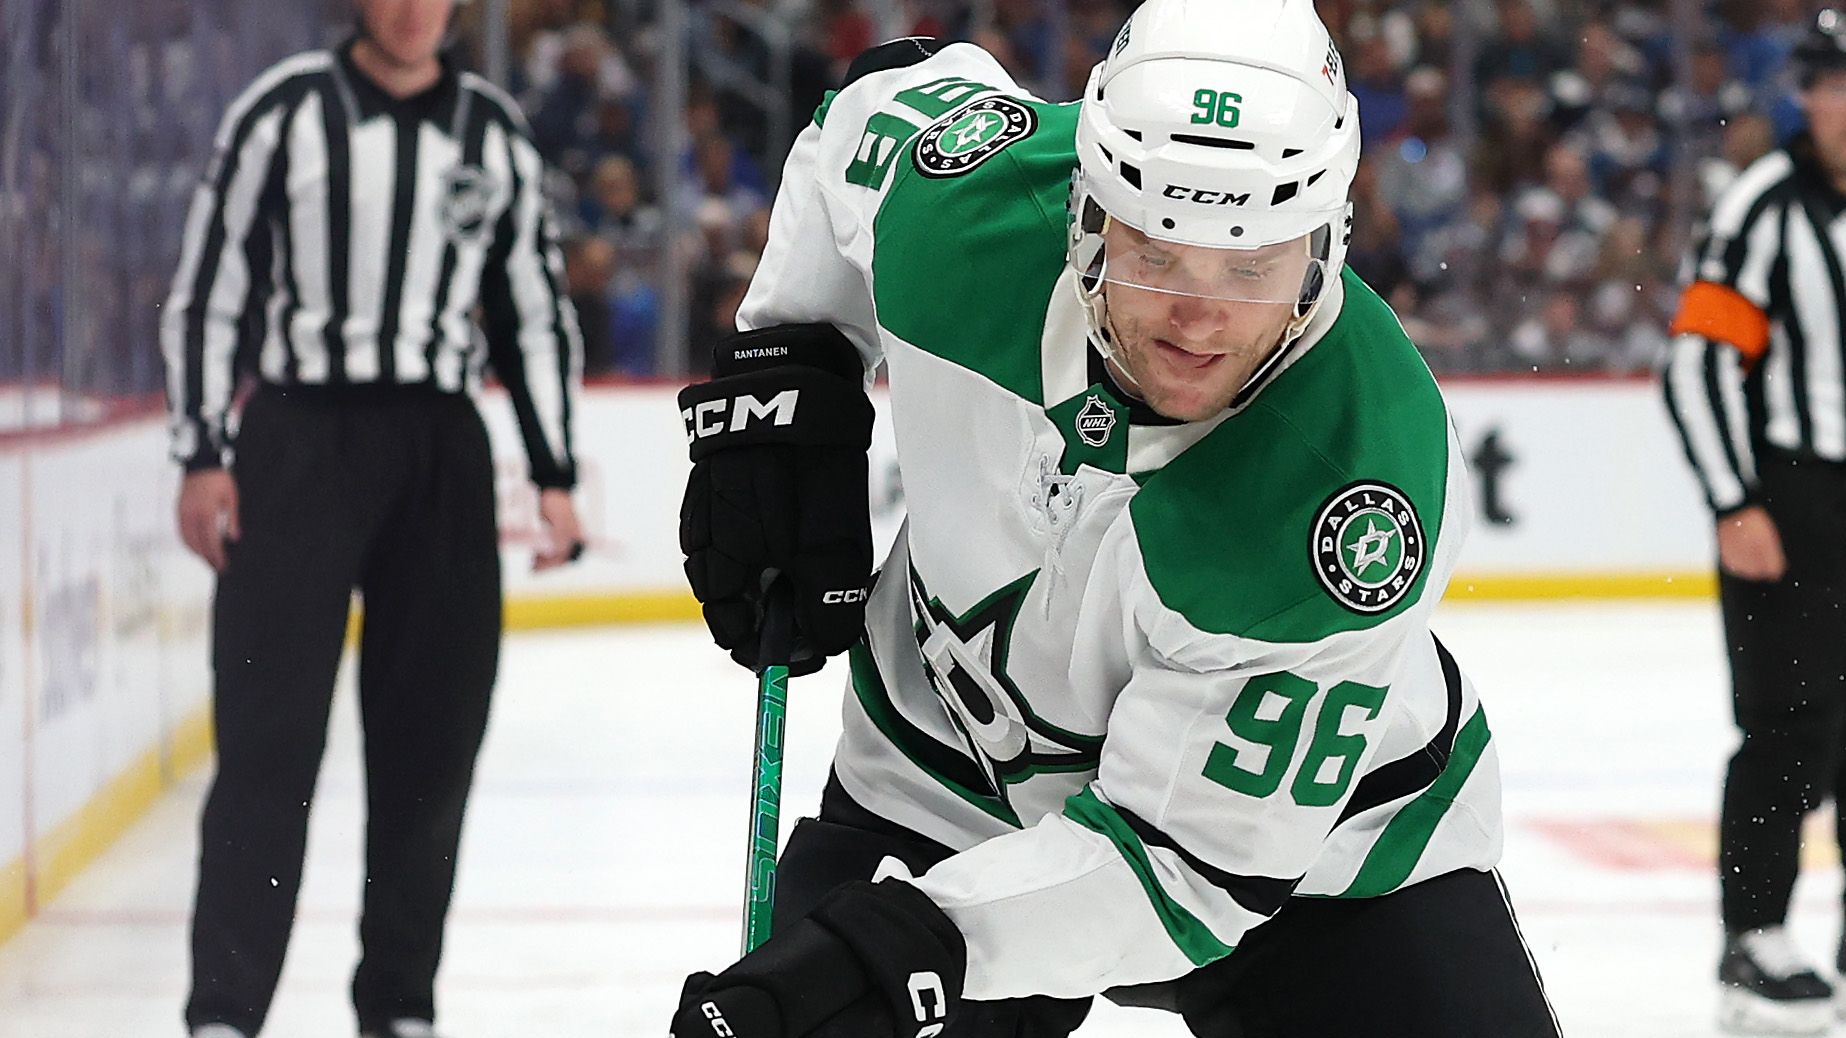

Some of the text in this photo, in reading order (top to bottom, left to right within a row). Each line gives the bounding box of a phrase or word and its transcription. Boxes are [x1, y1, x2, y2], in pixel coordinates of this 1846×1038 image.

[1191, 88, 1243, 128] 96
[1162, 184, 1252, 206] CCM
[734, 346, 788, 360] RANTANEN
[1082, 417, 1107, 428] NHL
[1322, 493, 1410, 554] DALLAS
[1338, 555, 1415, 602] STARS
[1201, 670, 1391, 807] 96
